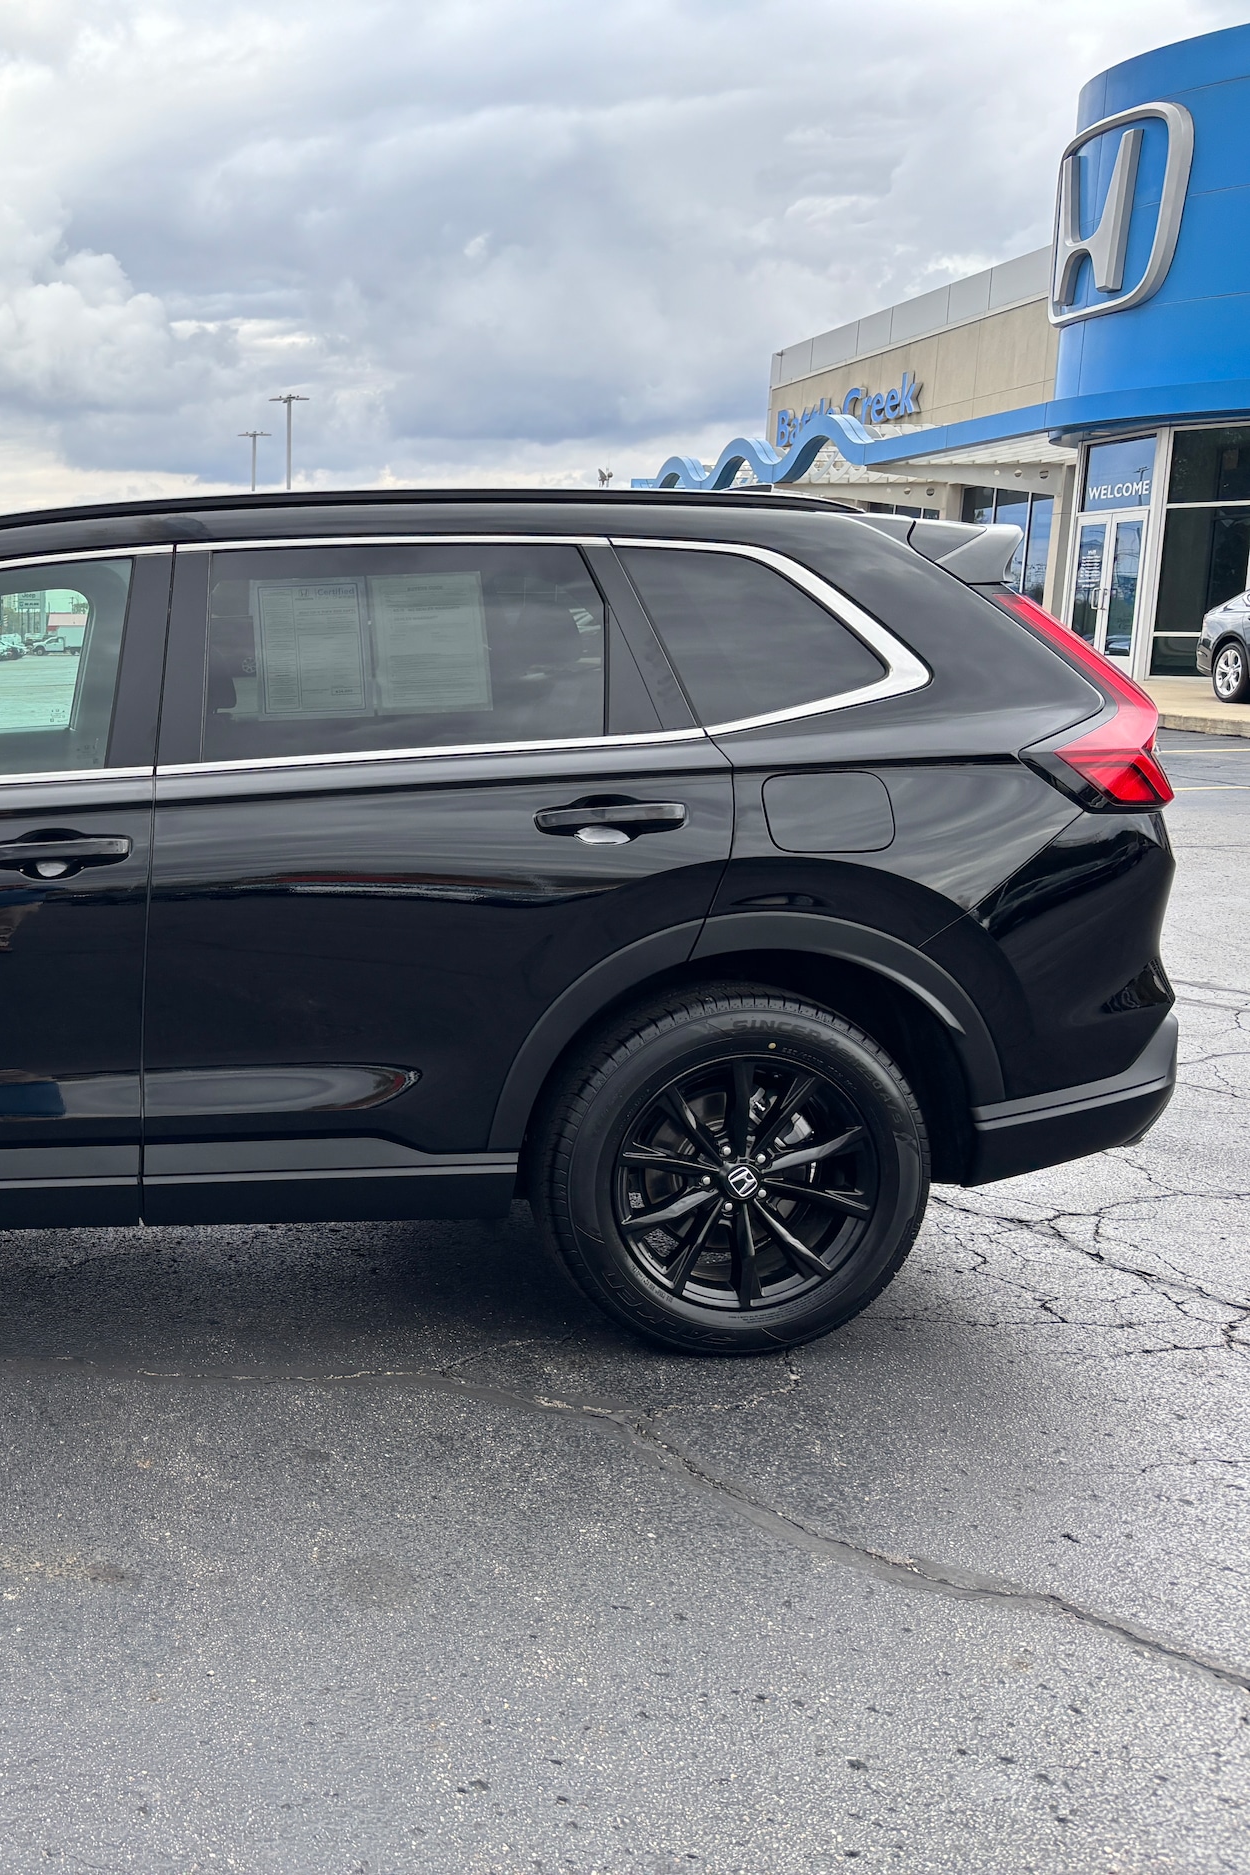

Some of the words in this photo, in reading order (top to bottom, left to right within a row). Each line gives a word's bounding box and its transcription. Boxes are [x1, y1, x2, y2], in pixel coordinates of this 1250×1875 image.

[843, 370, 923, 426] Creek
[1088, 480, 1150, 500] WELCOME
[317, 587, 355, 596] Certified
